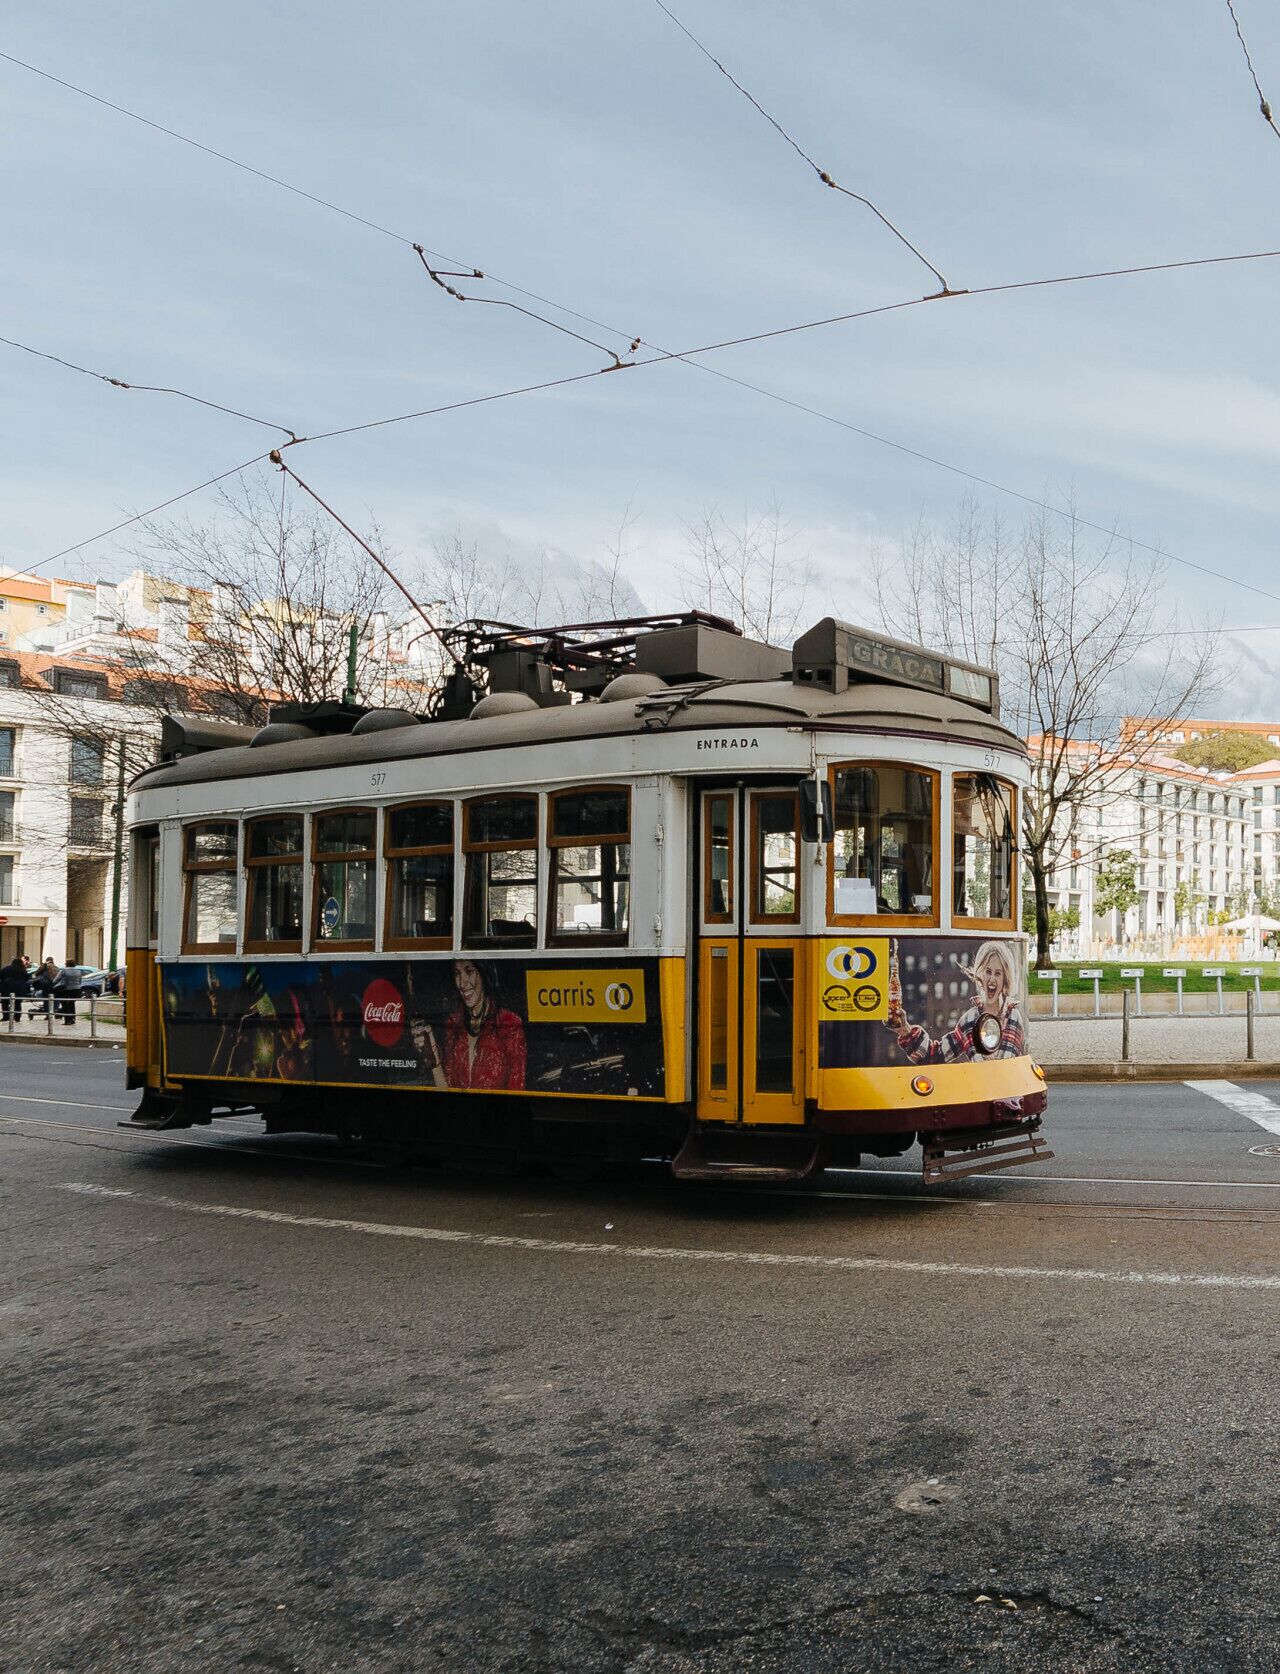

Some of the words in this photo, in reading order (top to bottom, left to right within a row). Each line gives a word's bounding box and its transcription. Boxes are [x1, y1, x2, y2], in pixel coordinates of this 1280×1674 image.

[854, 641, 935, 682] GRAÇA
[697, 738, 759, 750] ENTRADA
[984, 754, 1001, 769] 577
[371, 773, 387, 786] 577
[538, 981, 595, 1007] carris
[359, 1059, 377, 1067] TASTE
[379, 1059, 390, 1068] THE
[391, 1060, 417, 1069] FEELING
